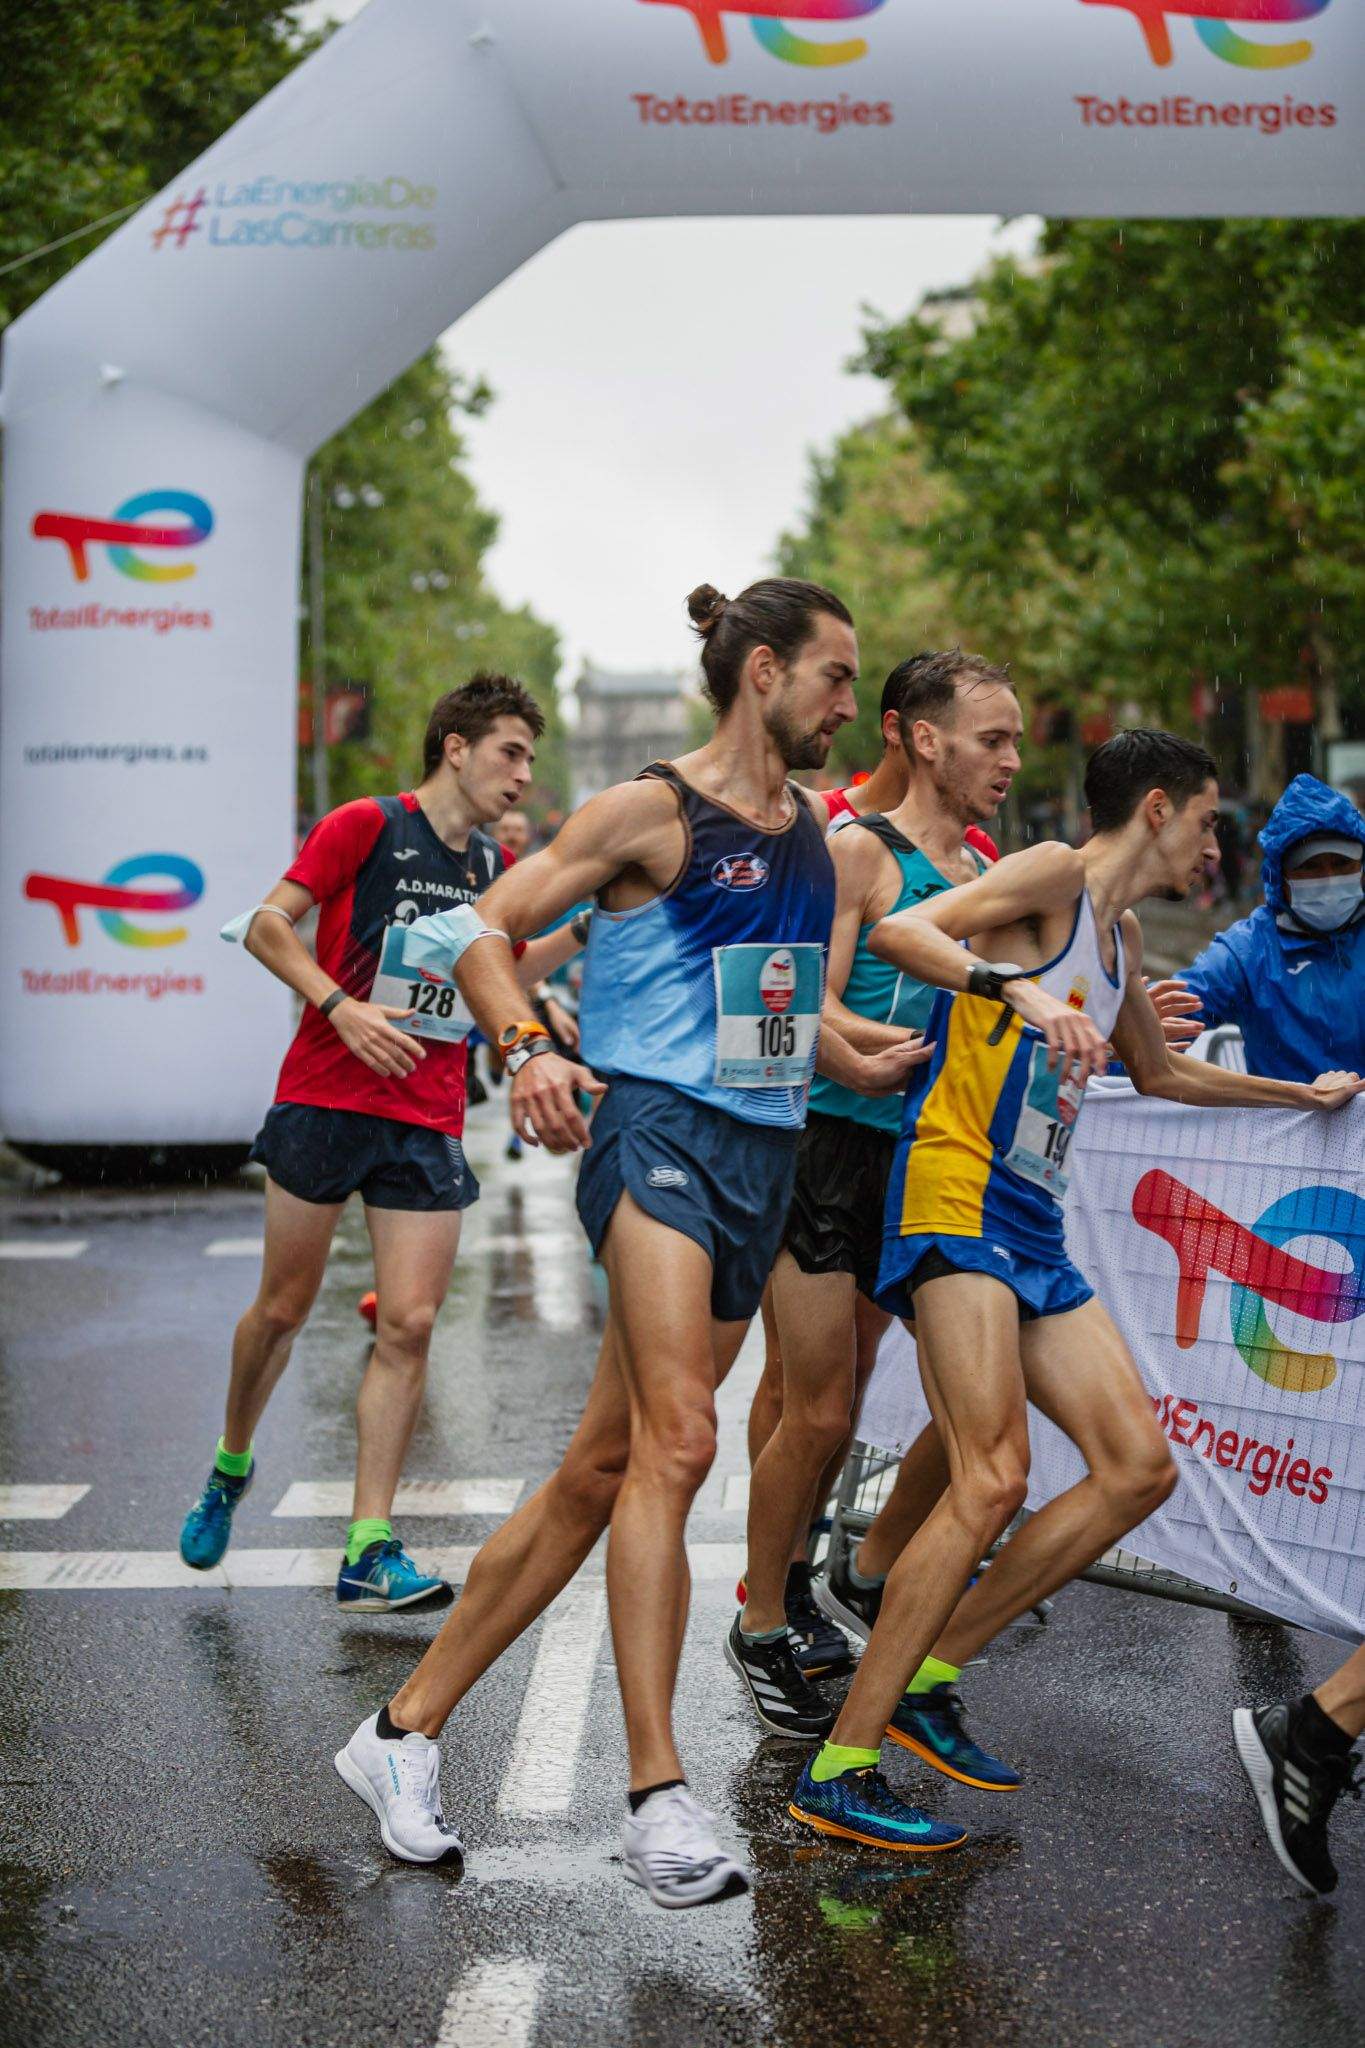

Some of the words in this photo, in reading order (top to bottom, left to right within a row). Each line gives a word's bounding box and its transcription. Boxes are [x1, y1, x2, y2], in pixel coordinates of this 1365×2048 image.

[631, 92, 894, 134] TotalEnergies
[1074, 93, 1337, 135] TotalEnergies
[208, 211, 437, 250] LasCarreras
[29, 603, 213, 635] TotalEnergies
[20, 967, 205, 1000] TotalEnergies
[408, 982, 456, 1019] 128
[756, 1016, 796, 1058] 105
